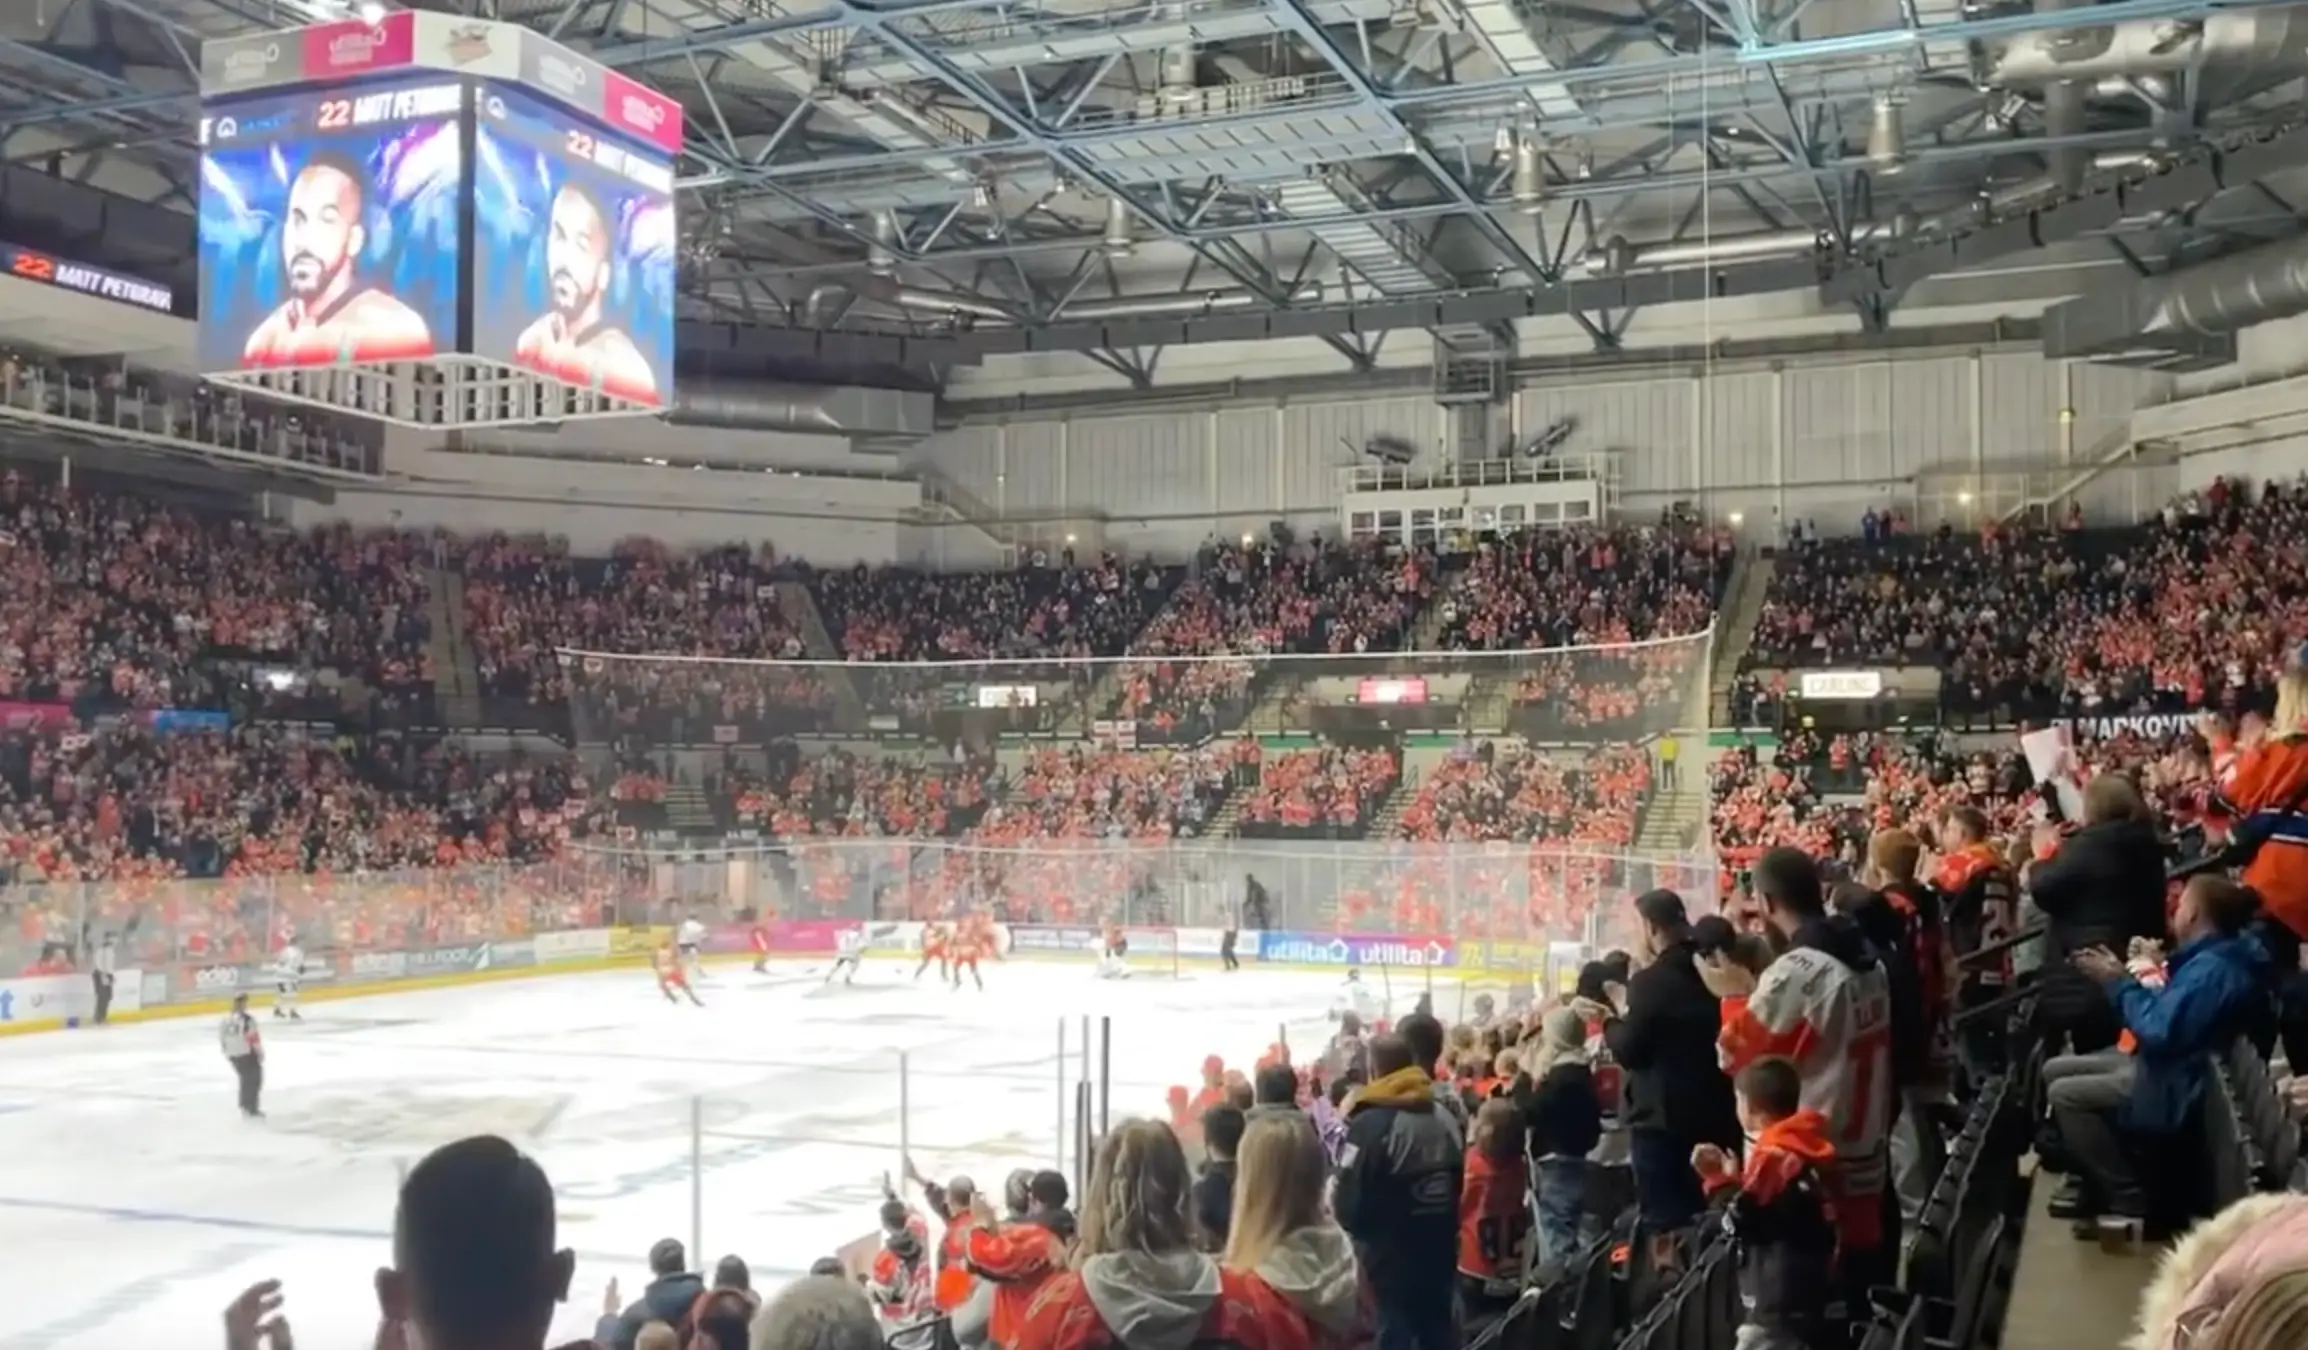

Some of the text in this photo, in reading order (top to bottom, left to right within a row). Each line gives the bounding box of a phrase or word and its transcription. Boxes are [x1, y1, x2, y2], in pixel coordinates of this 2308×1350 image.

[318, 99, 350, 129] 22
[566, 129, 593, 160] 22
[13, 254, 54, 279] 22
[55, 264, 102, 291] MATT
[1267, 940, 1328, 961] utilita
[1359, 942, 1422, 965] utilita
